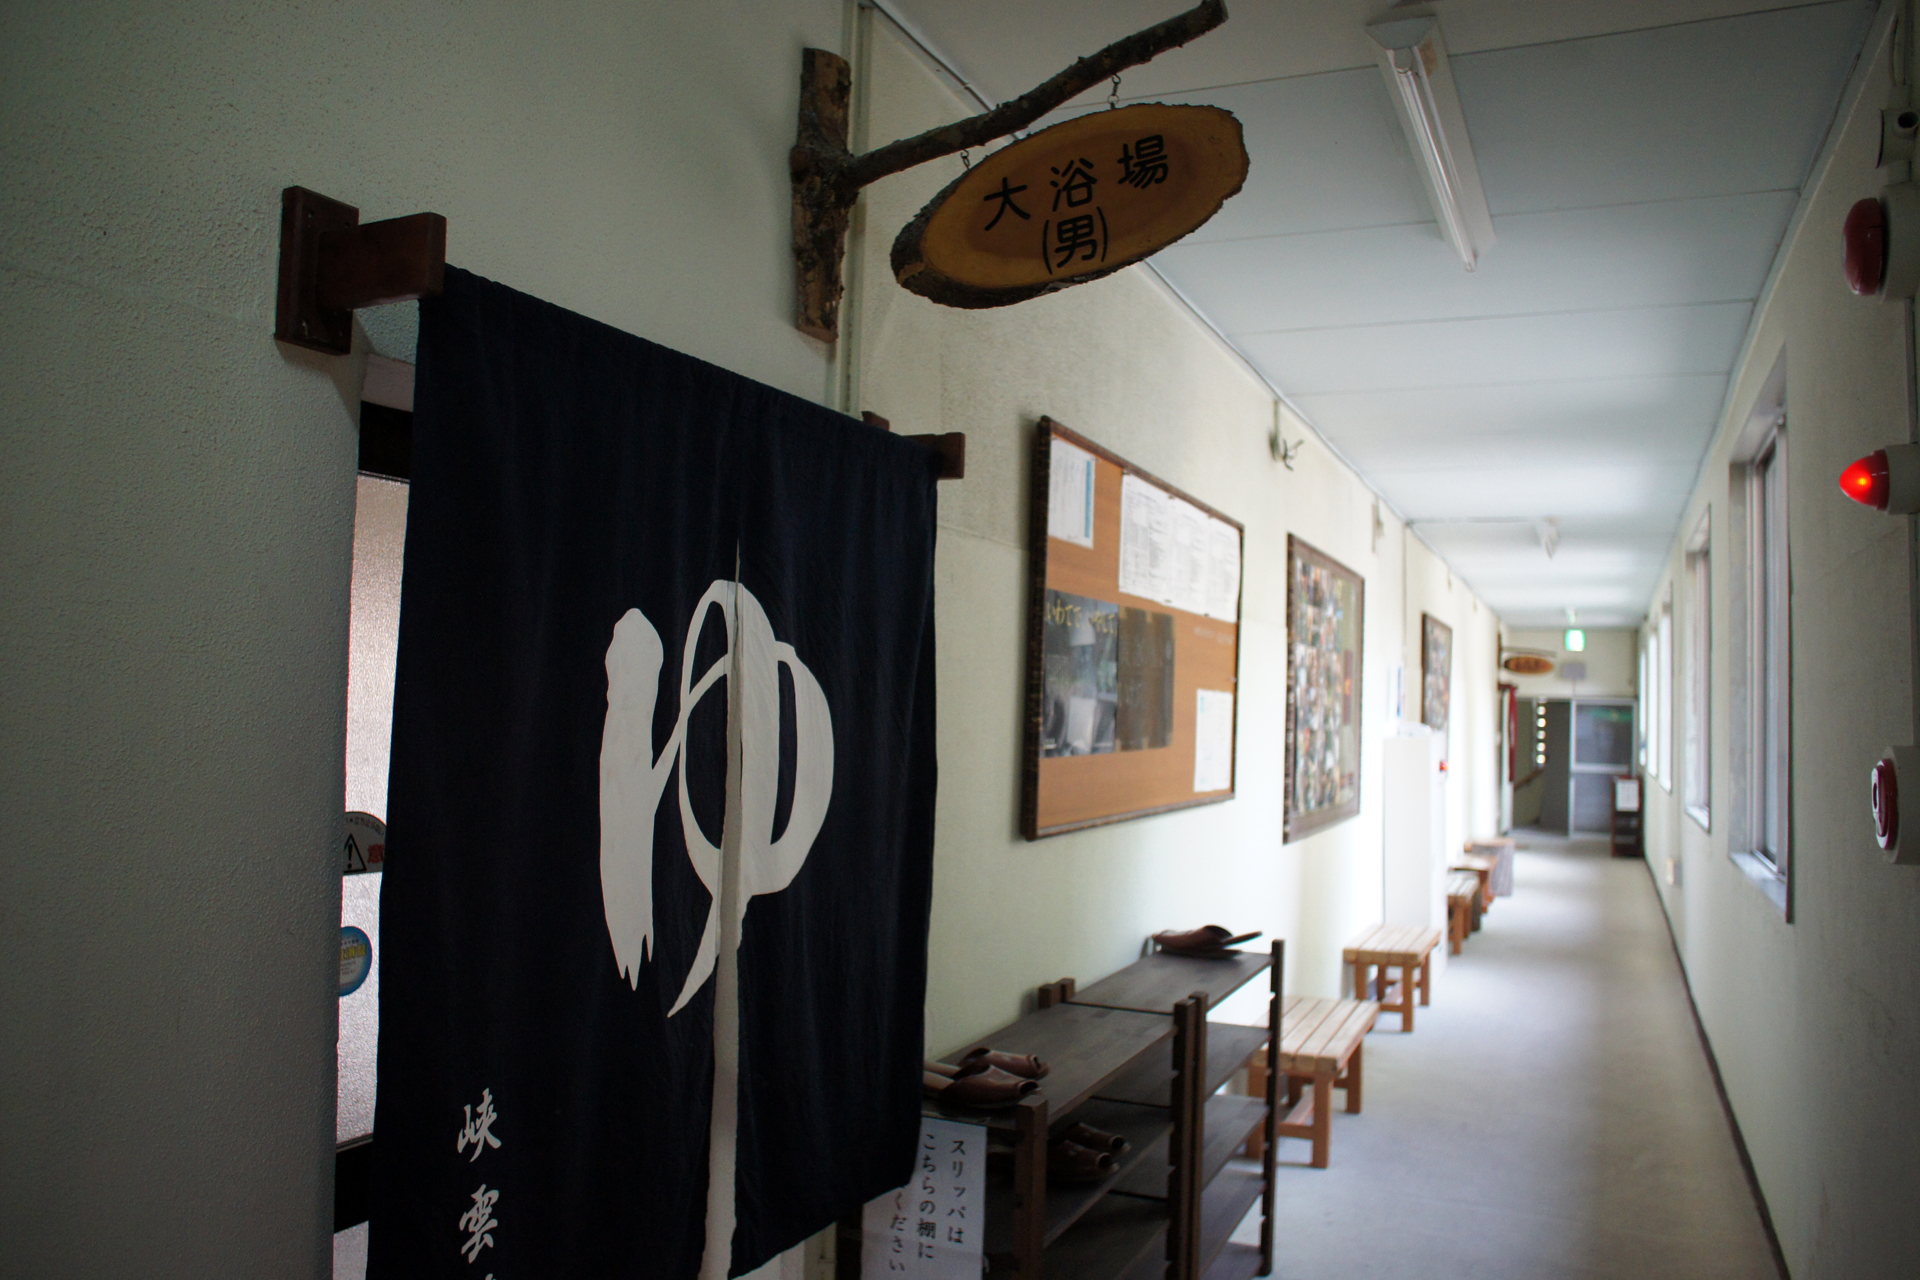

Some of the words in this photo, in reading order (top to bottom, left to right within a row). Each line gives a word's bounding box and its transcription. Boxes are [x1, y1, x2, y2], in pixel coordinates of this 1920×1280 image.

[983, 134, 1169, 231] 大浴場
[1042, 206, 1109, 275] (男)
[600, 579, 835, 1018] ゆ
[457, 1087, 502, 1280] 峡雲
[916, 1133, 937, 1259] こちらの棚に
[947, 1139, 967, 1244] スリッパは
